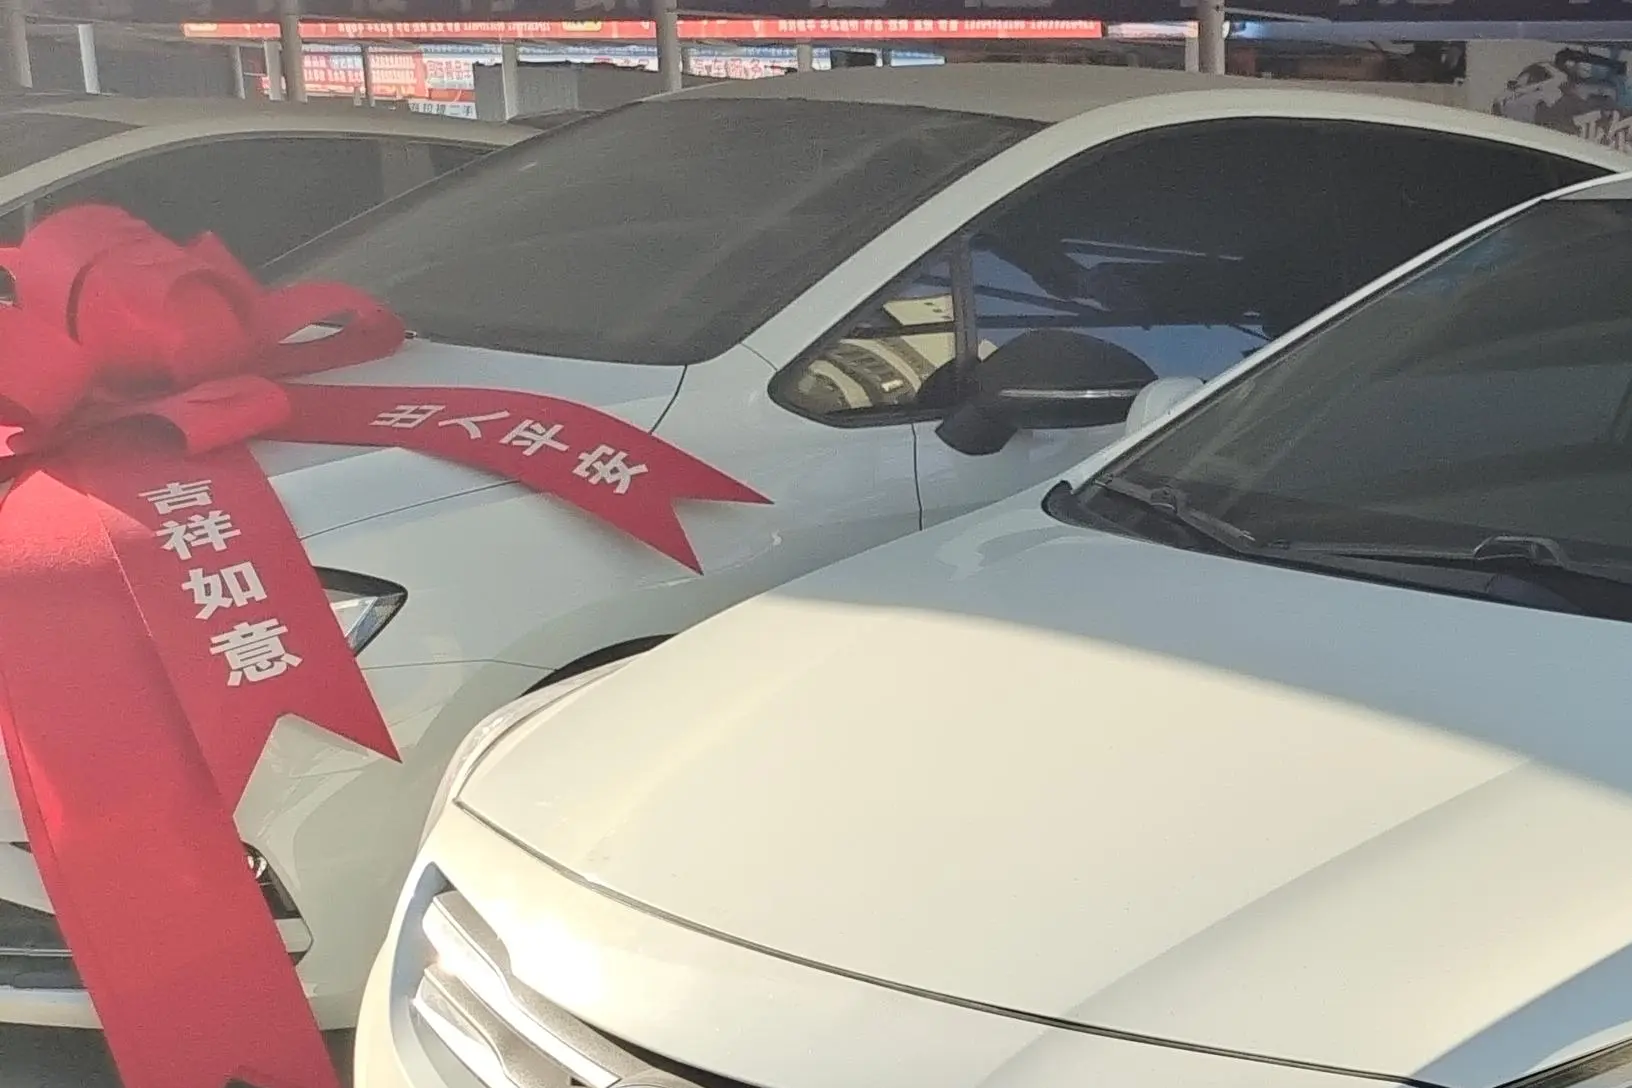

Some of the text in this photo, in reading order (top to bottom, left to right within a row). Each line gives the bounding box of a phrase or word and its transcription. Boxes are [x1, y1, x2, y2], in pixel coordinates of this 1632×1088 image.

[368, 402, 649, 496] 出人平安
[137, 478, 303, 687] 吉祥如意
